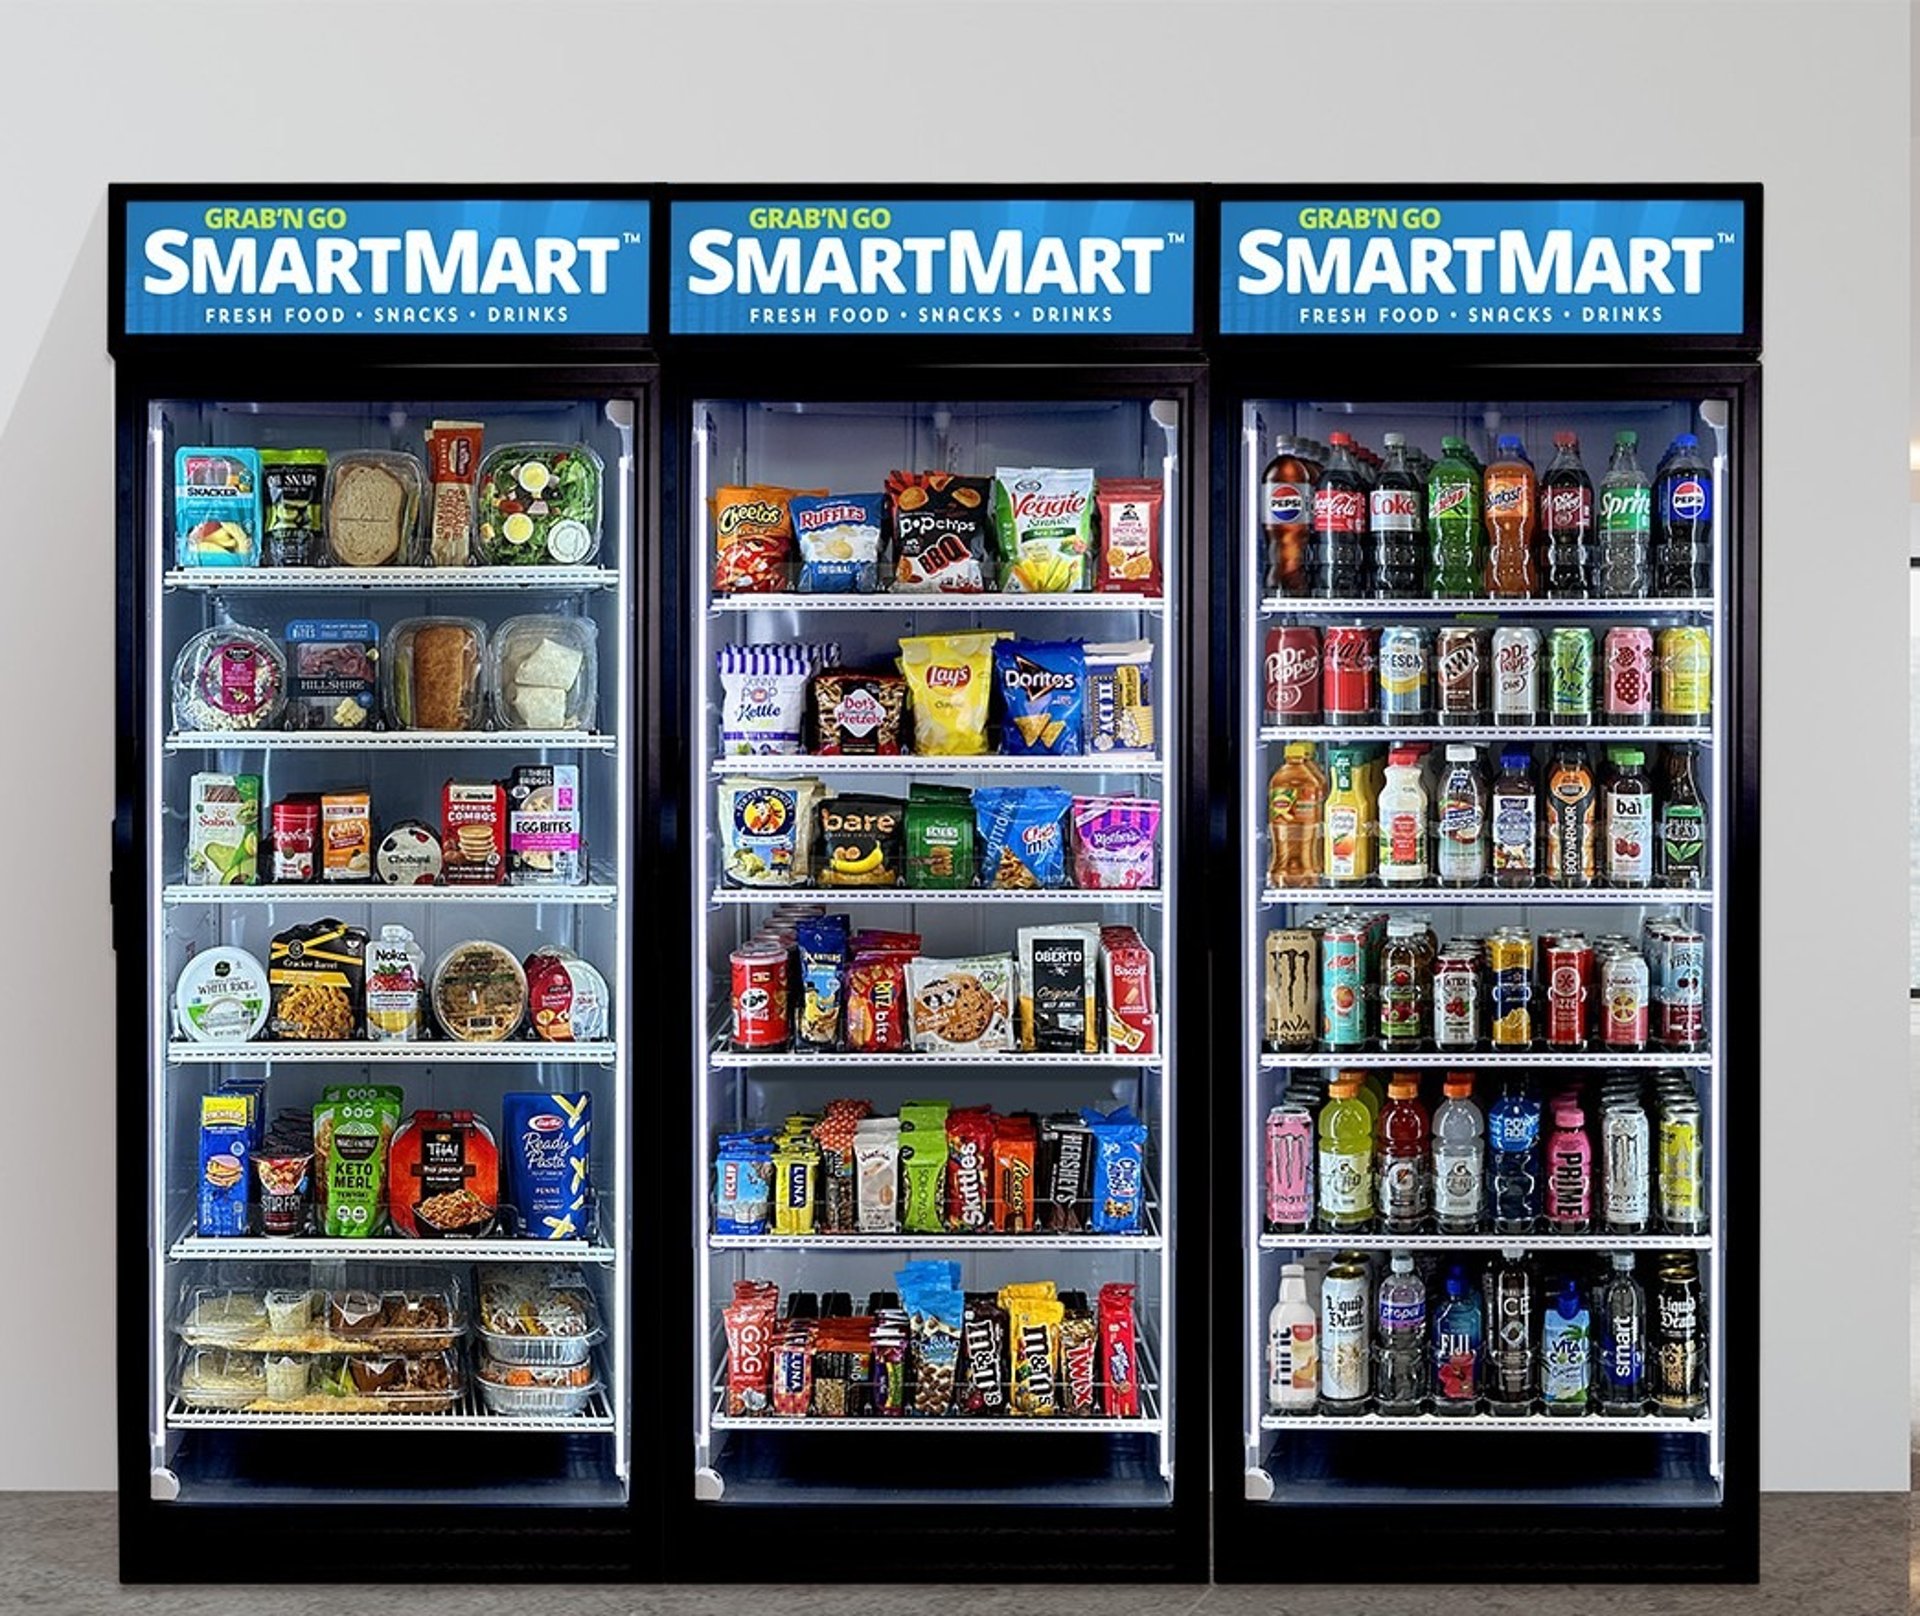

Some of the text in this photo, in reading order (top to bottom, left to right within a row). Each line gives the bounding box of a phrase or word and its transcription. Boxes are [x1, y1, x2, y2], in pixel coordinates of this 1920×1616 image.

[205, 208, 348, 229] GRAB'N GO
[749, 208, 892, 229] GRAB'N GO
[1299, 208, 1442, 229] GRAB'N GO
[206, 306, 568, 323] FRESH FOOD SNACKS DRINKS
[750, 306, 1112, 323] FRESH FOOD SNACKS DRINKS
[1300, 306, 1662, 323] FRESH FOOD SNACKS DRINKS
[187, 487, 238, 497] SNACKER
[1011, 492, 1086, 519] Veggie
[1371, 492, 1417, 515] Coke
[719, 502, 783, 535] Cheetos
[801, 506, 866, 531] RUFFLES
[900, 514, 976, 538] popchips
[918, 534, 970, 576] BBQ
[817, 565, 851, 574] ORIGINAL
[1282, 647, 1306, 662] Dr
[1381, 654, 1420, 668] ESCA
[929, 665, 968, 687] Lay's
[1266, 652, 1318, 684] Pepper
[300, 679, 365, 690] HILLSHIRE
[1005, 670, 1074, 688] Doritos
[736, 702, 781, 721] Kettle
[844, 696, 877, 709] Dot's
[837, 713, 881, 725] Pretzels
[1099, 705, 1114, 734] ACT
[1616, 798, 1641, 814] bai
[198, 813, 236, 828] Sabra
[448, 812, 497, 822] COMBOS
[516, 821, 573, 833] EGG BITES
[820, 808, 896, 833] bare
[1565, 805, 1577, 875] BODYARMOR
[387, 854, 431, 865] Chobani
[282, 958, 338, 969] Cracker Barrel
[375, 949, 409, 961] Noka
[1034, 951, 1082, 963] OBERTO
[873, 981, 893, 1043] RITZ bits
[1270, 1015, 1311, 1031] JAVA
[426, 1142, 459, 1157] THAI
[522, 1132, 572, 1157] Ready
[335, 1163, 373, 1176] KETO
[525, 1150, 567, 1170] Pasta
[1056, 1134, 1084, 1209] HERSHEY'S
[334, 1176, 372, 1189] MEAL
[793, 1166, 805, 1204] LUNA
[958, 1141, 985, 1226] Skittles
[1012, 1157, 1030, 1214] Reese's
[1556, 1152, 1583, 1215] PRIME
[918, 1169, 929, 1226] PISTACHIOS
[1382, 1305, 1420, 1321] propel
[1503, 1298, 1532, 1316] CE
[741, 1325, 763, 1374] G2G
[1441, 1334, 1470, 1355] FIJI
[1552, 1340, 1581, 1352] VITA
[1614, 1316, 1631, 1377] smart
[791, 1353, 804, 1391] LUNA
[851, 1353, 861, 1381] KIND
